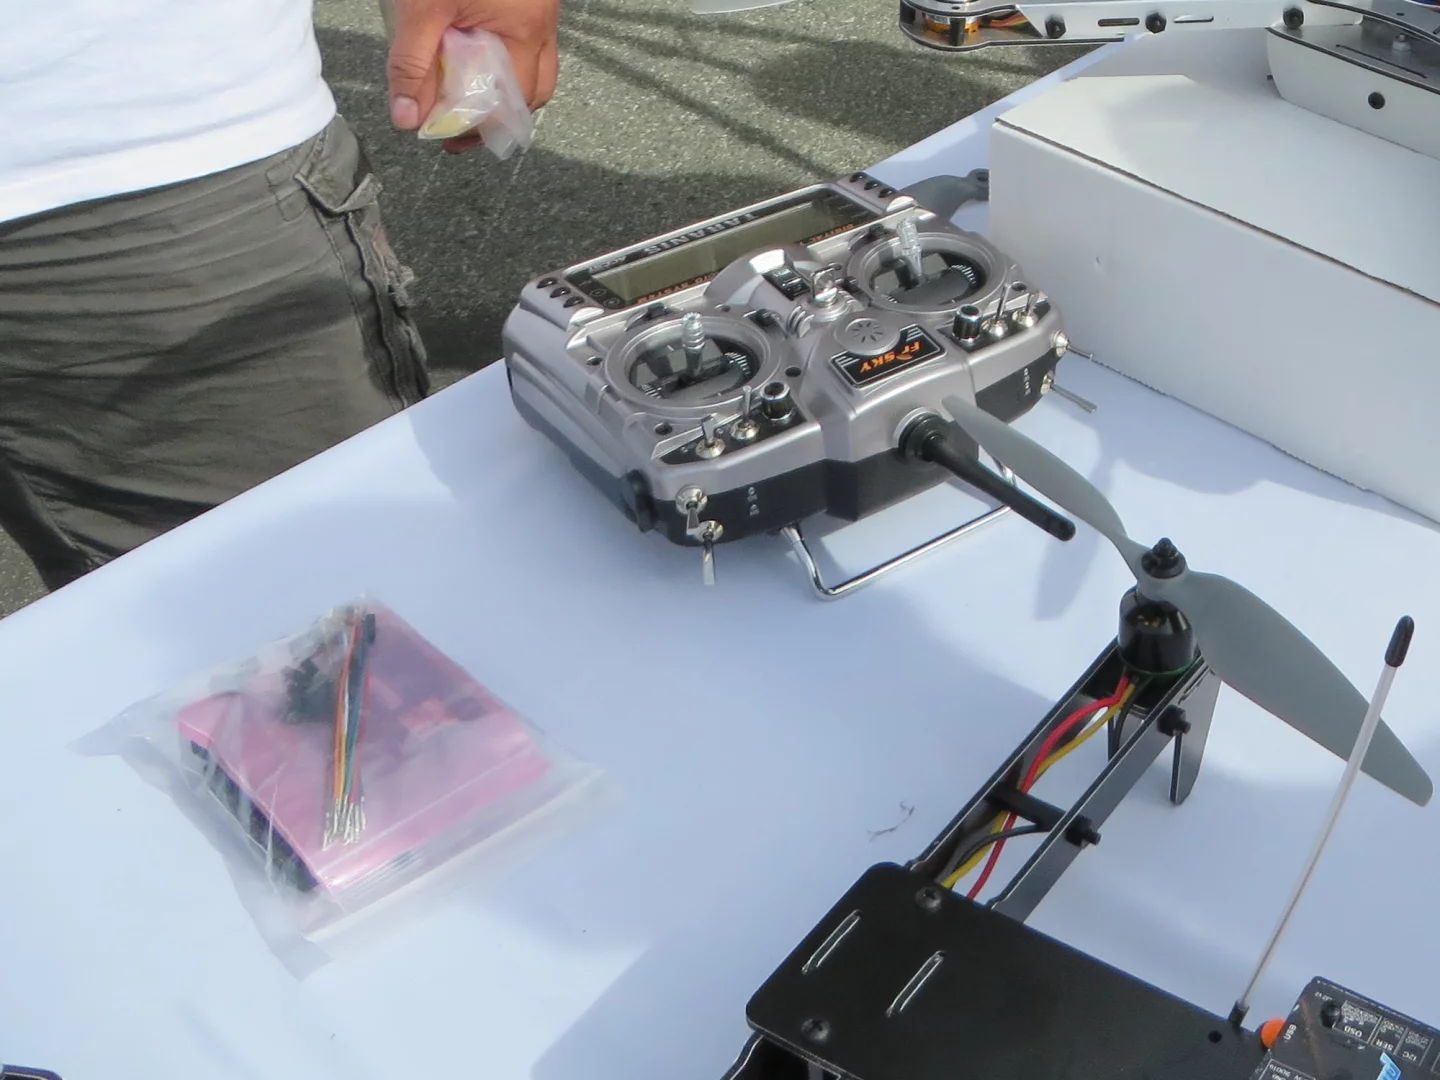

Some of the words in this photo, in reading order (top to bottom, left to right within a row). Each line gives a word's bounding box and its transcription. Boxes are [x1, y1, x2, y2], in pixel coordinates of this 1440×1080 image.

[643, 213, 752, 256] TARANIS
[1285, 1024, 1297, 1040] USB
[1344, 1025, 1363, 1038] OSD
[1375, 1038, 1394, 1051] SER
